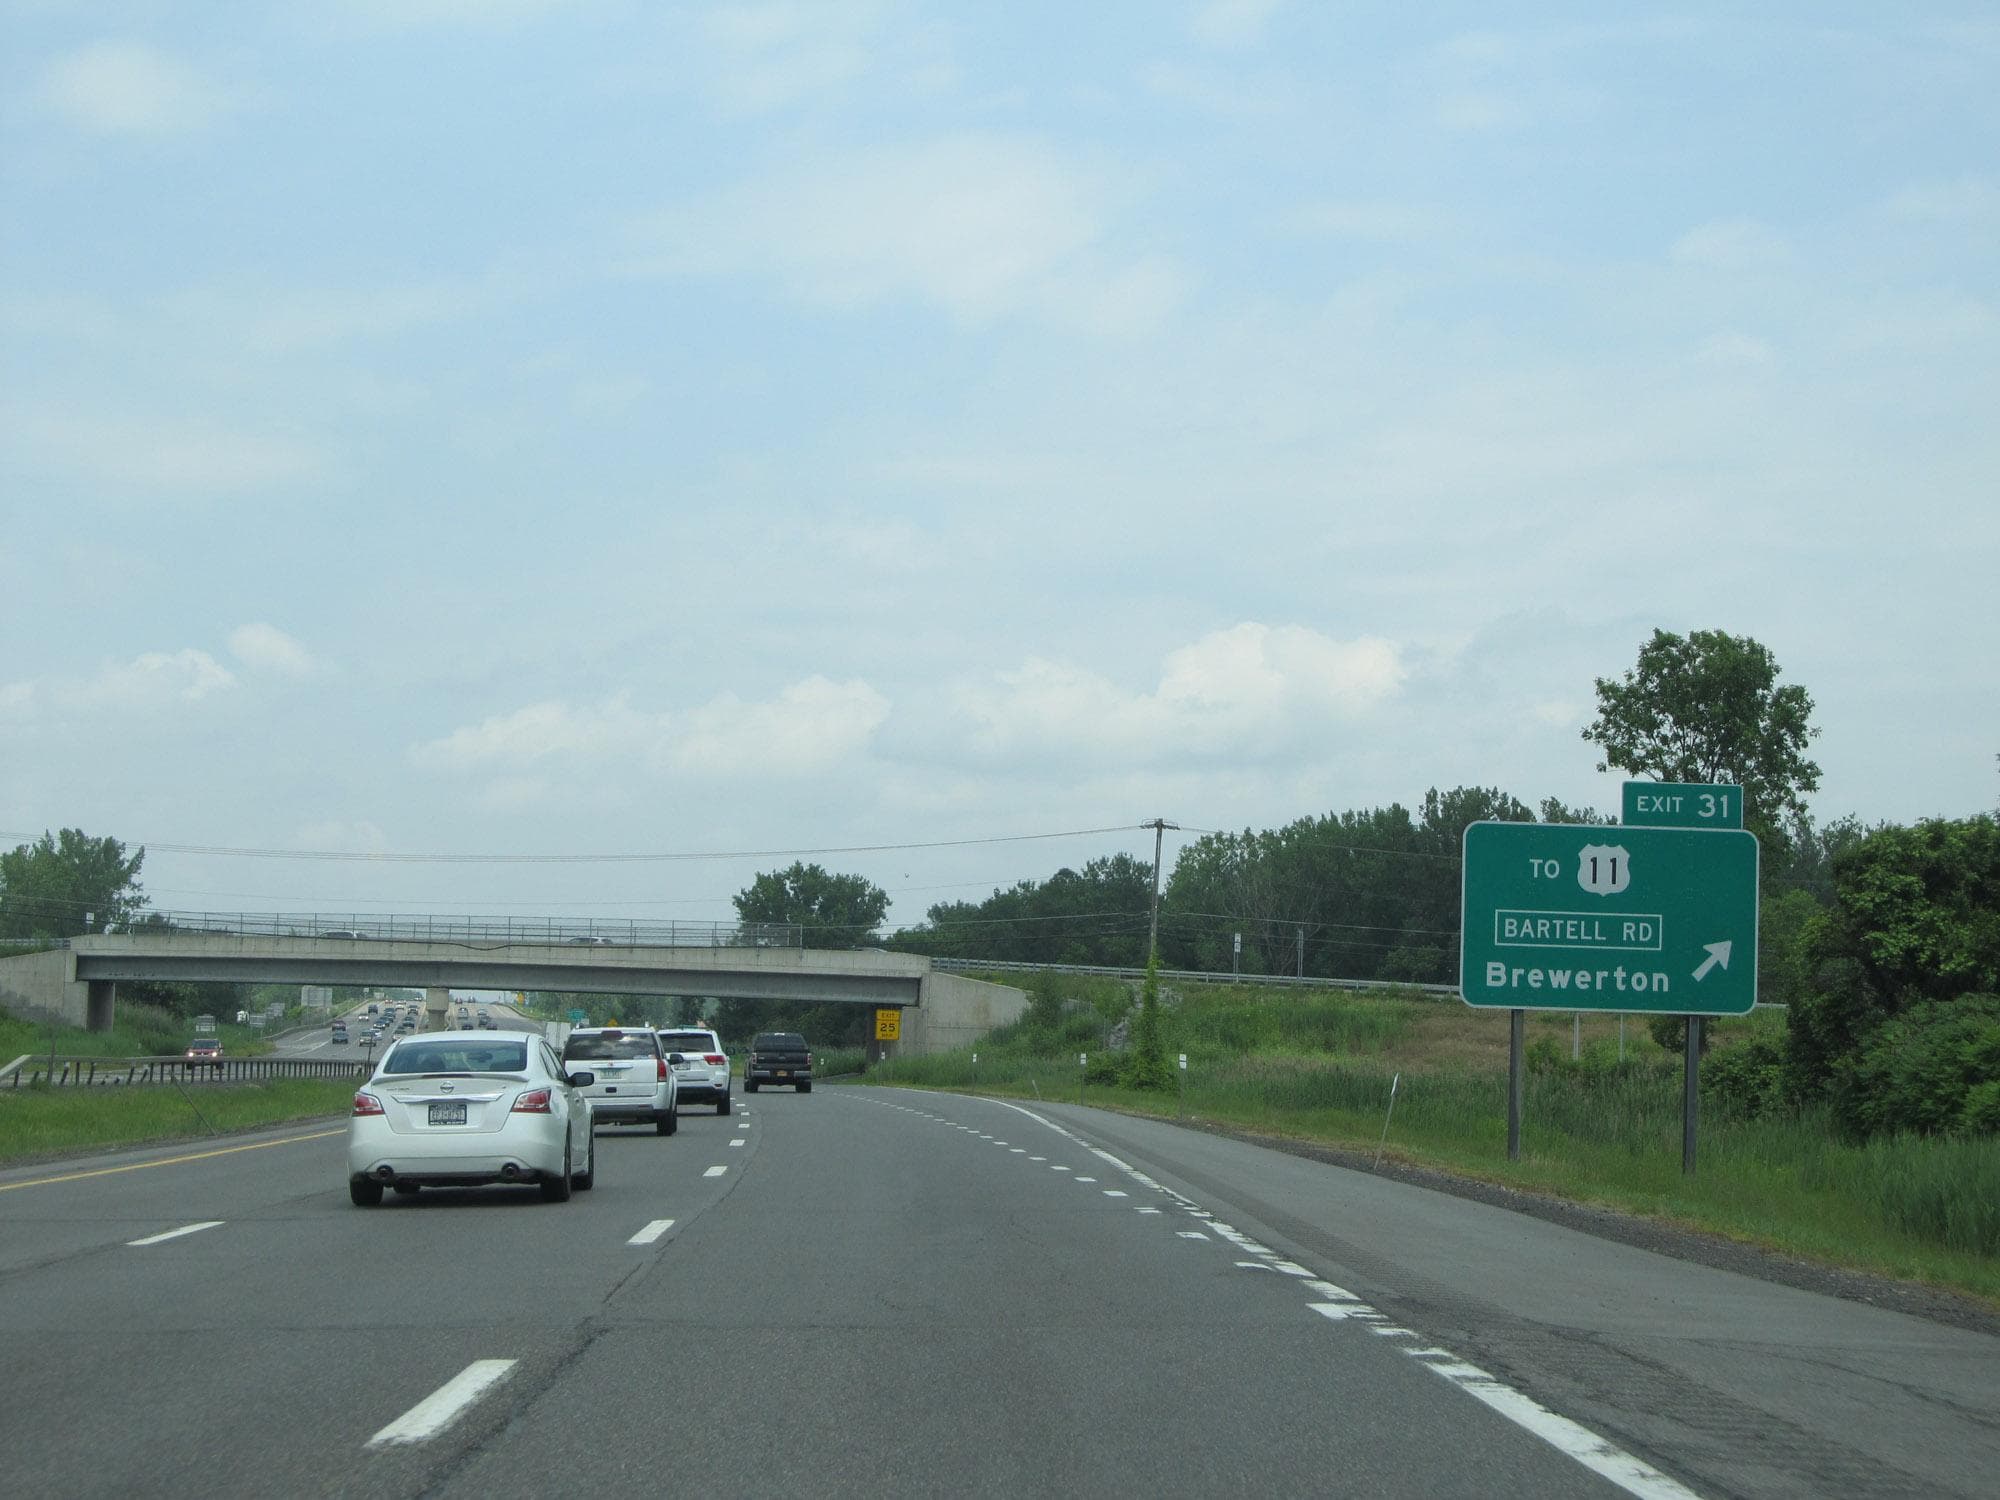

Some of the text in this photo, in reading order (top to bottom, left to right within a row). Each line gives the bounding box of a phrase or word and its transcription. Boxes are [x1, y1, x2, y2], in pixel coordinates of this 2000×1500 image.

[1637, 793, 1728, 818] EXIT 31
[1529, 857, 1617, 885] TO 11
[1504, 918, 1653, 942] BARTELL RD
[1485, 961, 1669, 992] Brewerton
[880, 1023, 896, 1032] 25
